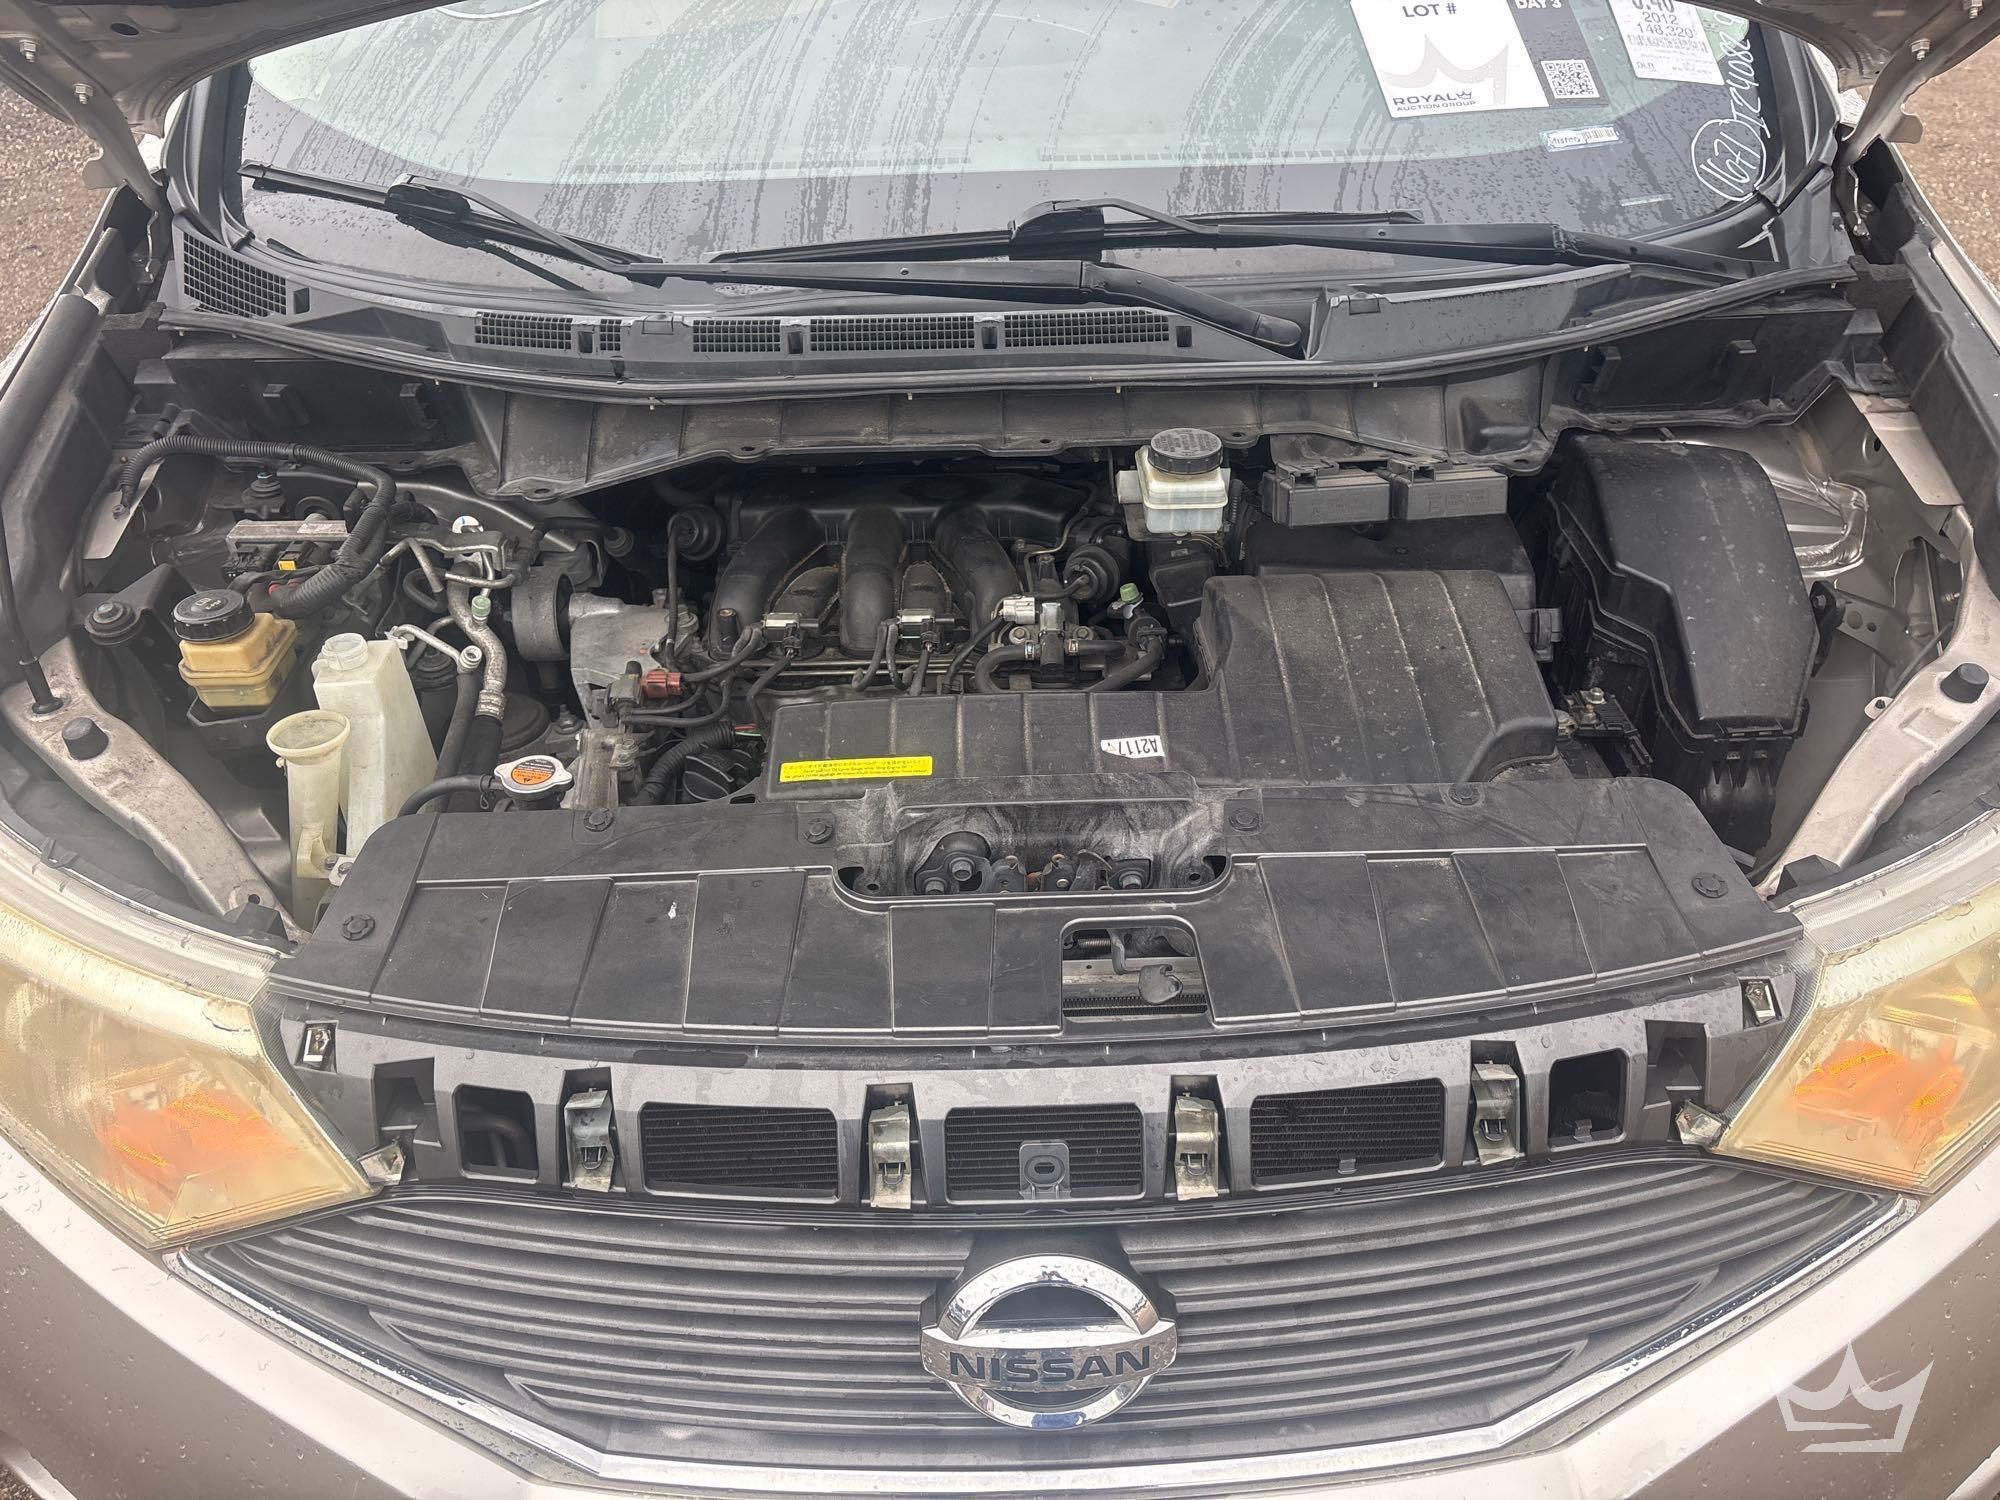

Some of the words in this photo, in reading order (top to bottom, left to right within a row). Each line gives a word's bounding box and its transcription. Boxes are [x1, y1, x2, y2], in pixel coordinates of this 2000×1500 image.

[1402, 4, 1440, 17] LOT
[1446, 2, 1457, 15] #
[1642, 11, 1680, 25] 2012
[1393, 93, 1457, 105] ROYAL
[1442, 100, 1476, 108] GROUP
[950, 1345, 1150, 1383] NISSAN
